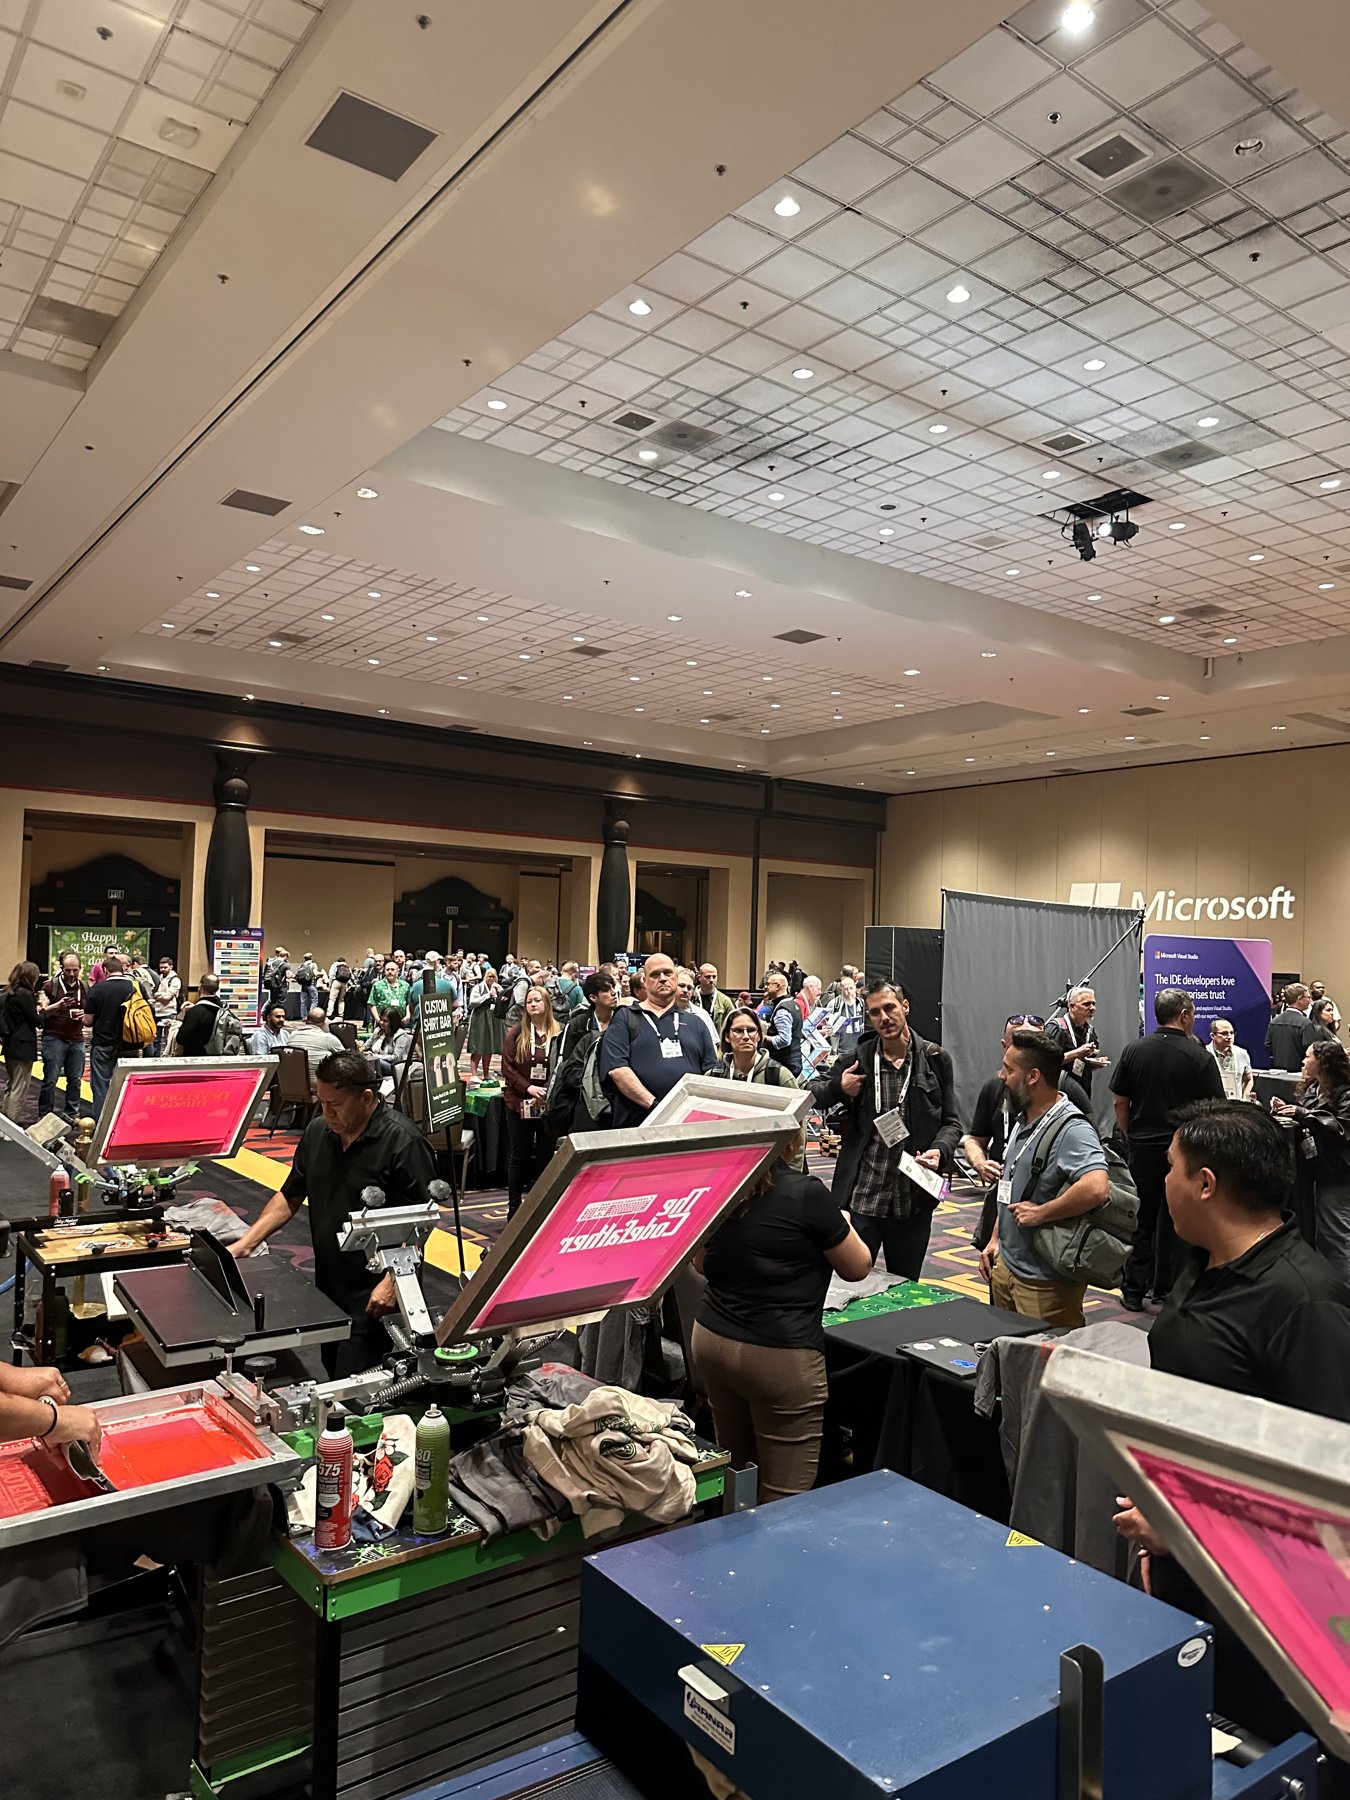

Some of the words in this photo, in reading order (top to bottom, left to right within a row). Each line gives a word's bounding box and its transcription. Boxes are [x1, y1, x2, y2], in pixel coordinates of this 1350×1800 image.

[1131, 886, 1295, 922] Microsoft
[81, 931, 118, 945] Happy
[1154, 973, 1169, 985] The
[1169, 974, 1182, 985] IDE
[1182, 974, 1221, 988] developers
[1220, 975, 1236, 987] love
[1209, 990, 1226, 1000] trust
[424, 999, 448, 1015] CUSTOM
[423, 1016, 439, 1033] SHIRT
[439, 1014, 453, 1030] BAR
[318, 1463, 341, 1477] 575
